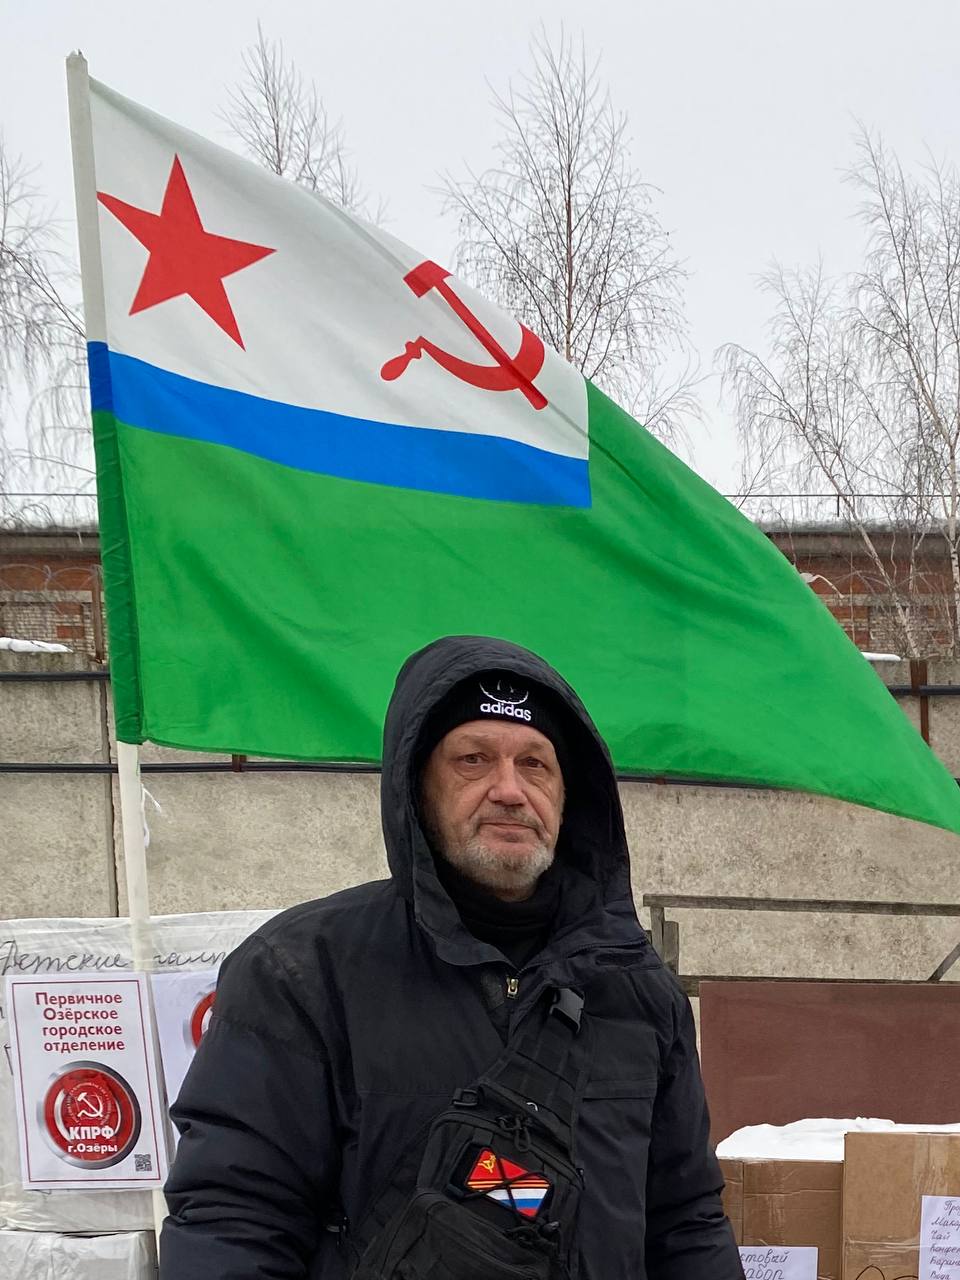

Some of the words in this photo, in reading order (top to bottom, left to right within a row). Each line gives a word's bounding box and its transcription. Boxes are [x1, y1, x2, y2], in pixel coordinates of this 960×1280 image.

[480, 702, 532, 721] adidas
[35, 991, 122, 1008] Первичное
[43, 1007, 118, 1023] Озёрское
[43, 1024, 122, 1039] городское
[44, 1039, 125, 1053] отделение
[69, 1126, 114, 1141] КПРФ
[68, 1141, 118, 1154] г.Озёры
